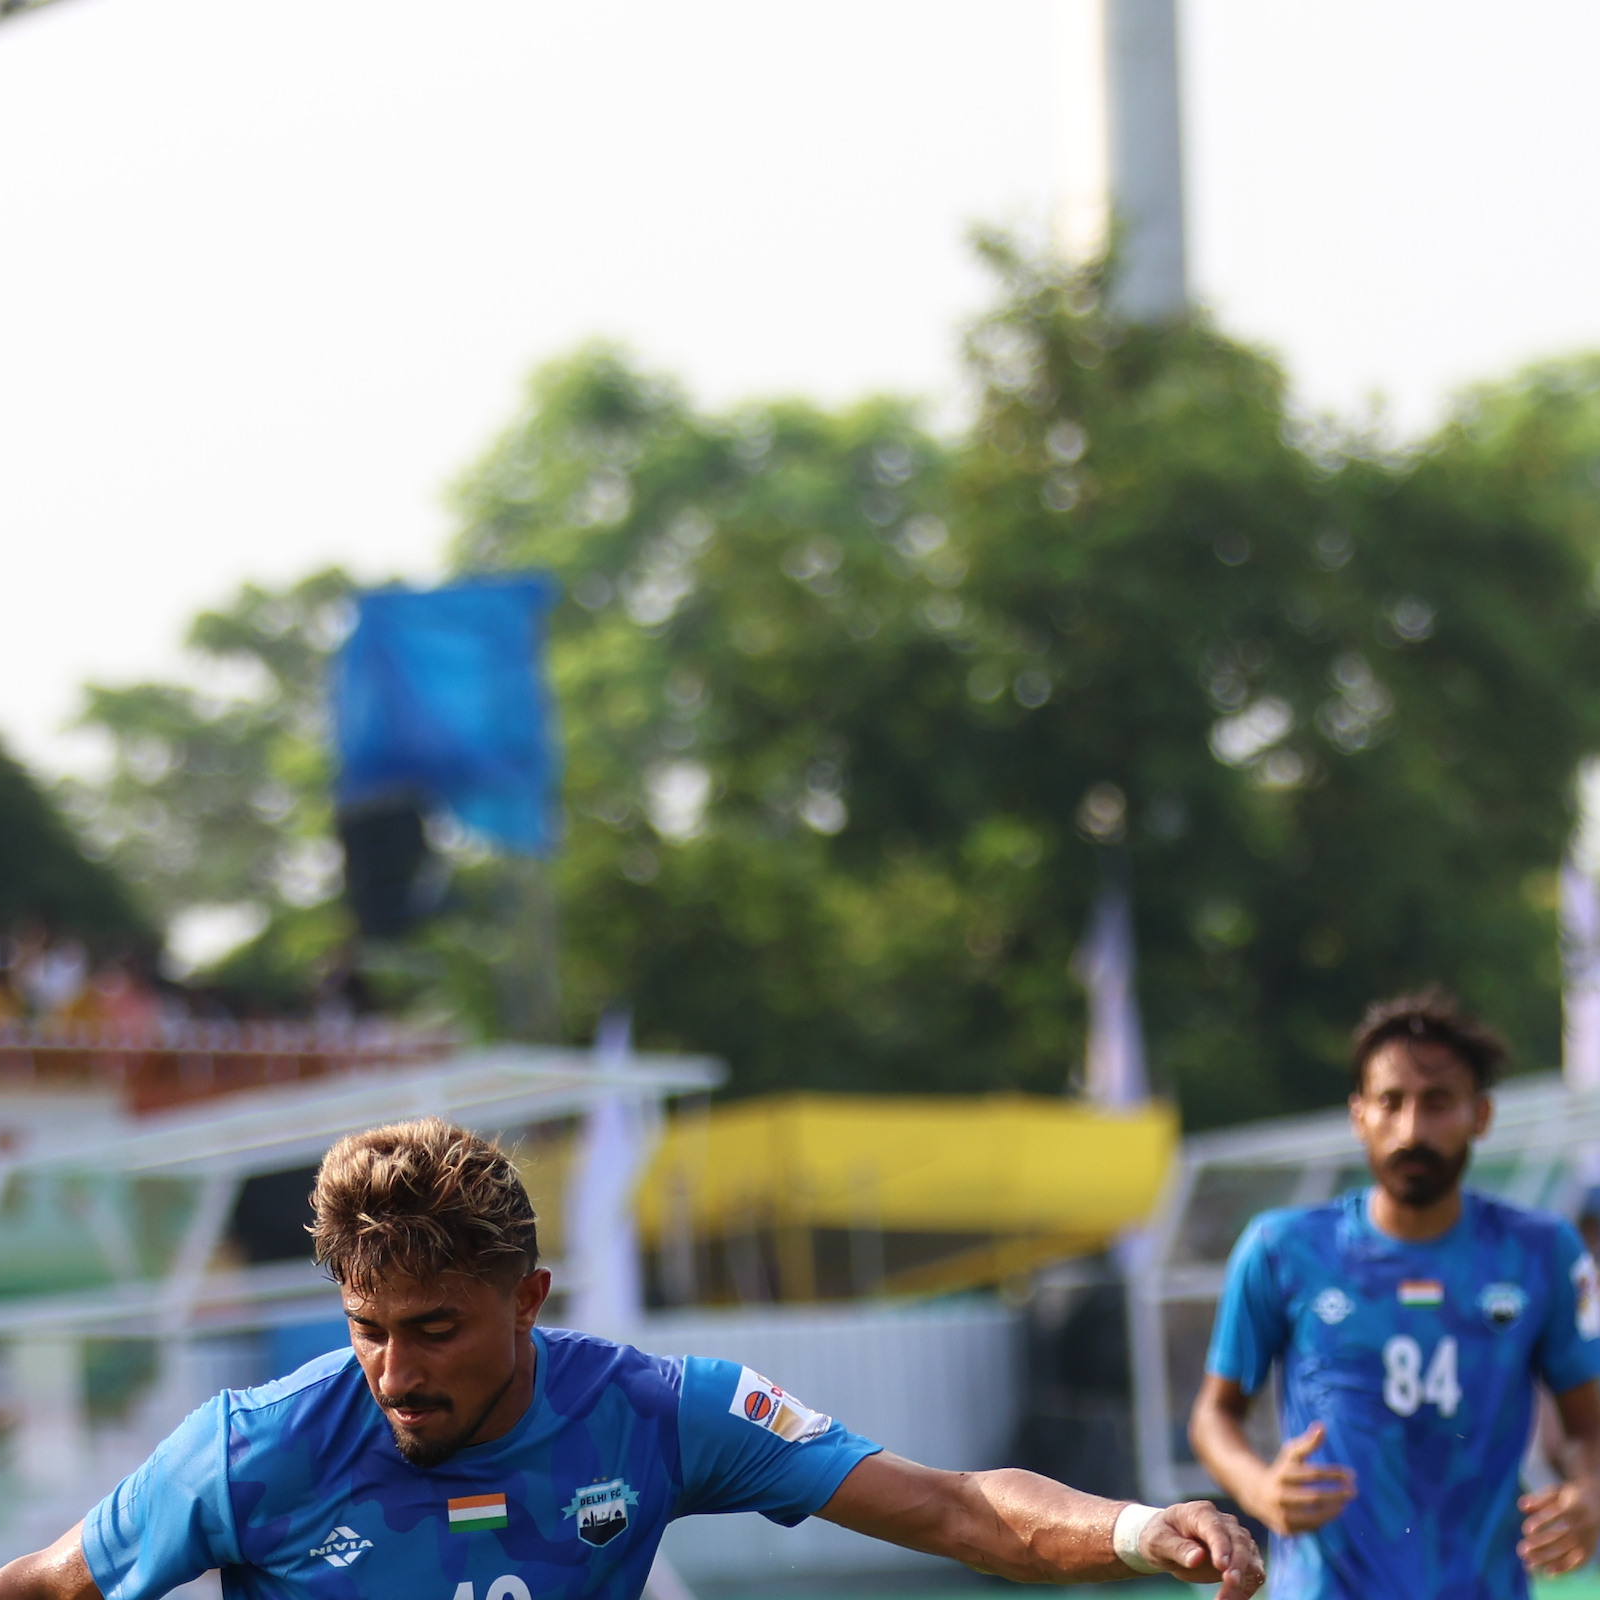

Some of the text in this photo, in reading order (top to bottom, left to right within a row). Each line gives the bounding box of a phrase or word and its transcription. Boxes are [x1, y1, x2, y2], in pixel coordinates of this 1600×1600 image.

[1382, 1334, 1462, 1418] 84
[580, 1488, 622, 1506] DELHI FC
[310, 1539, 374, 1557] NIVIA
